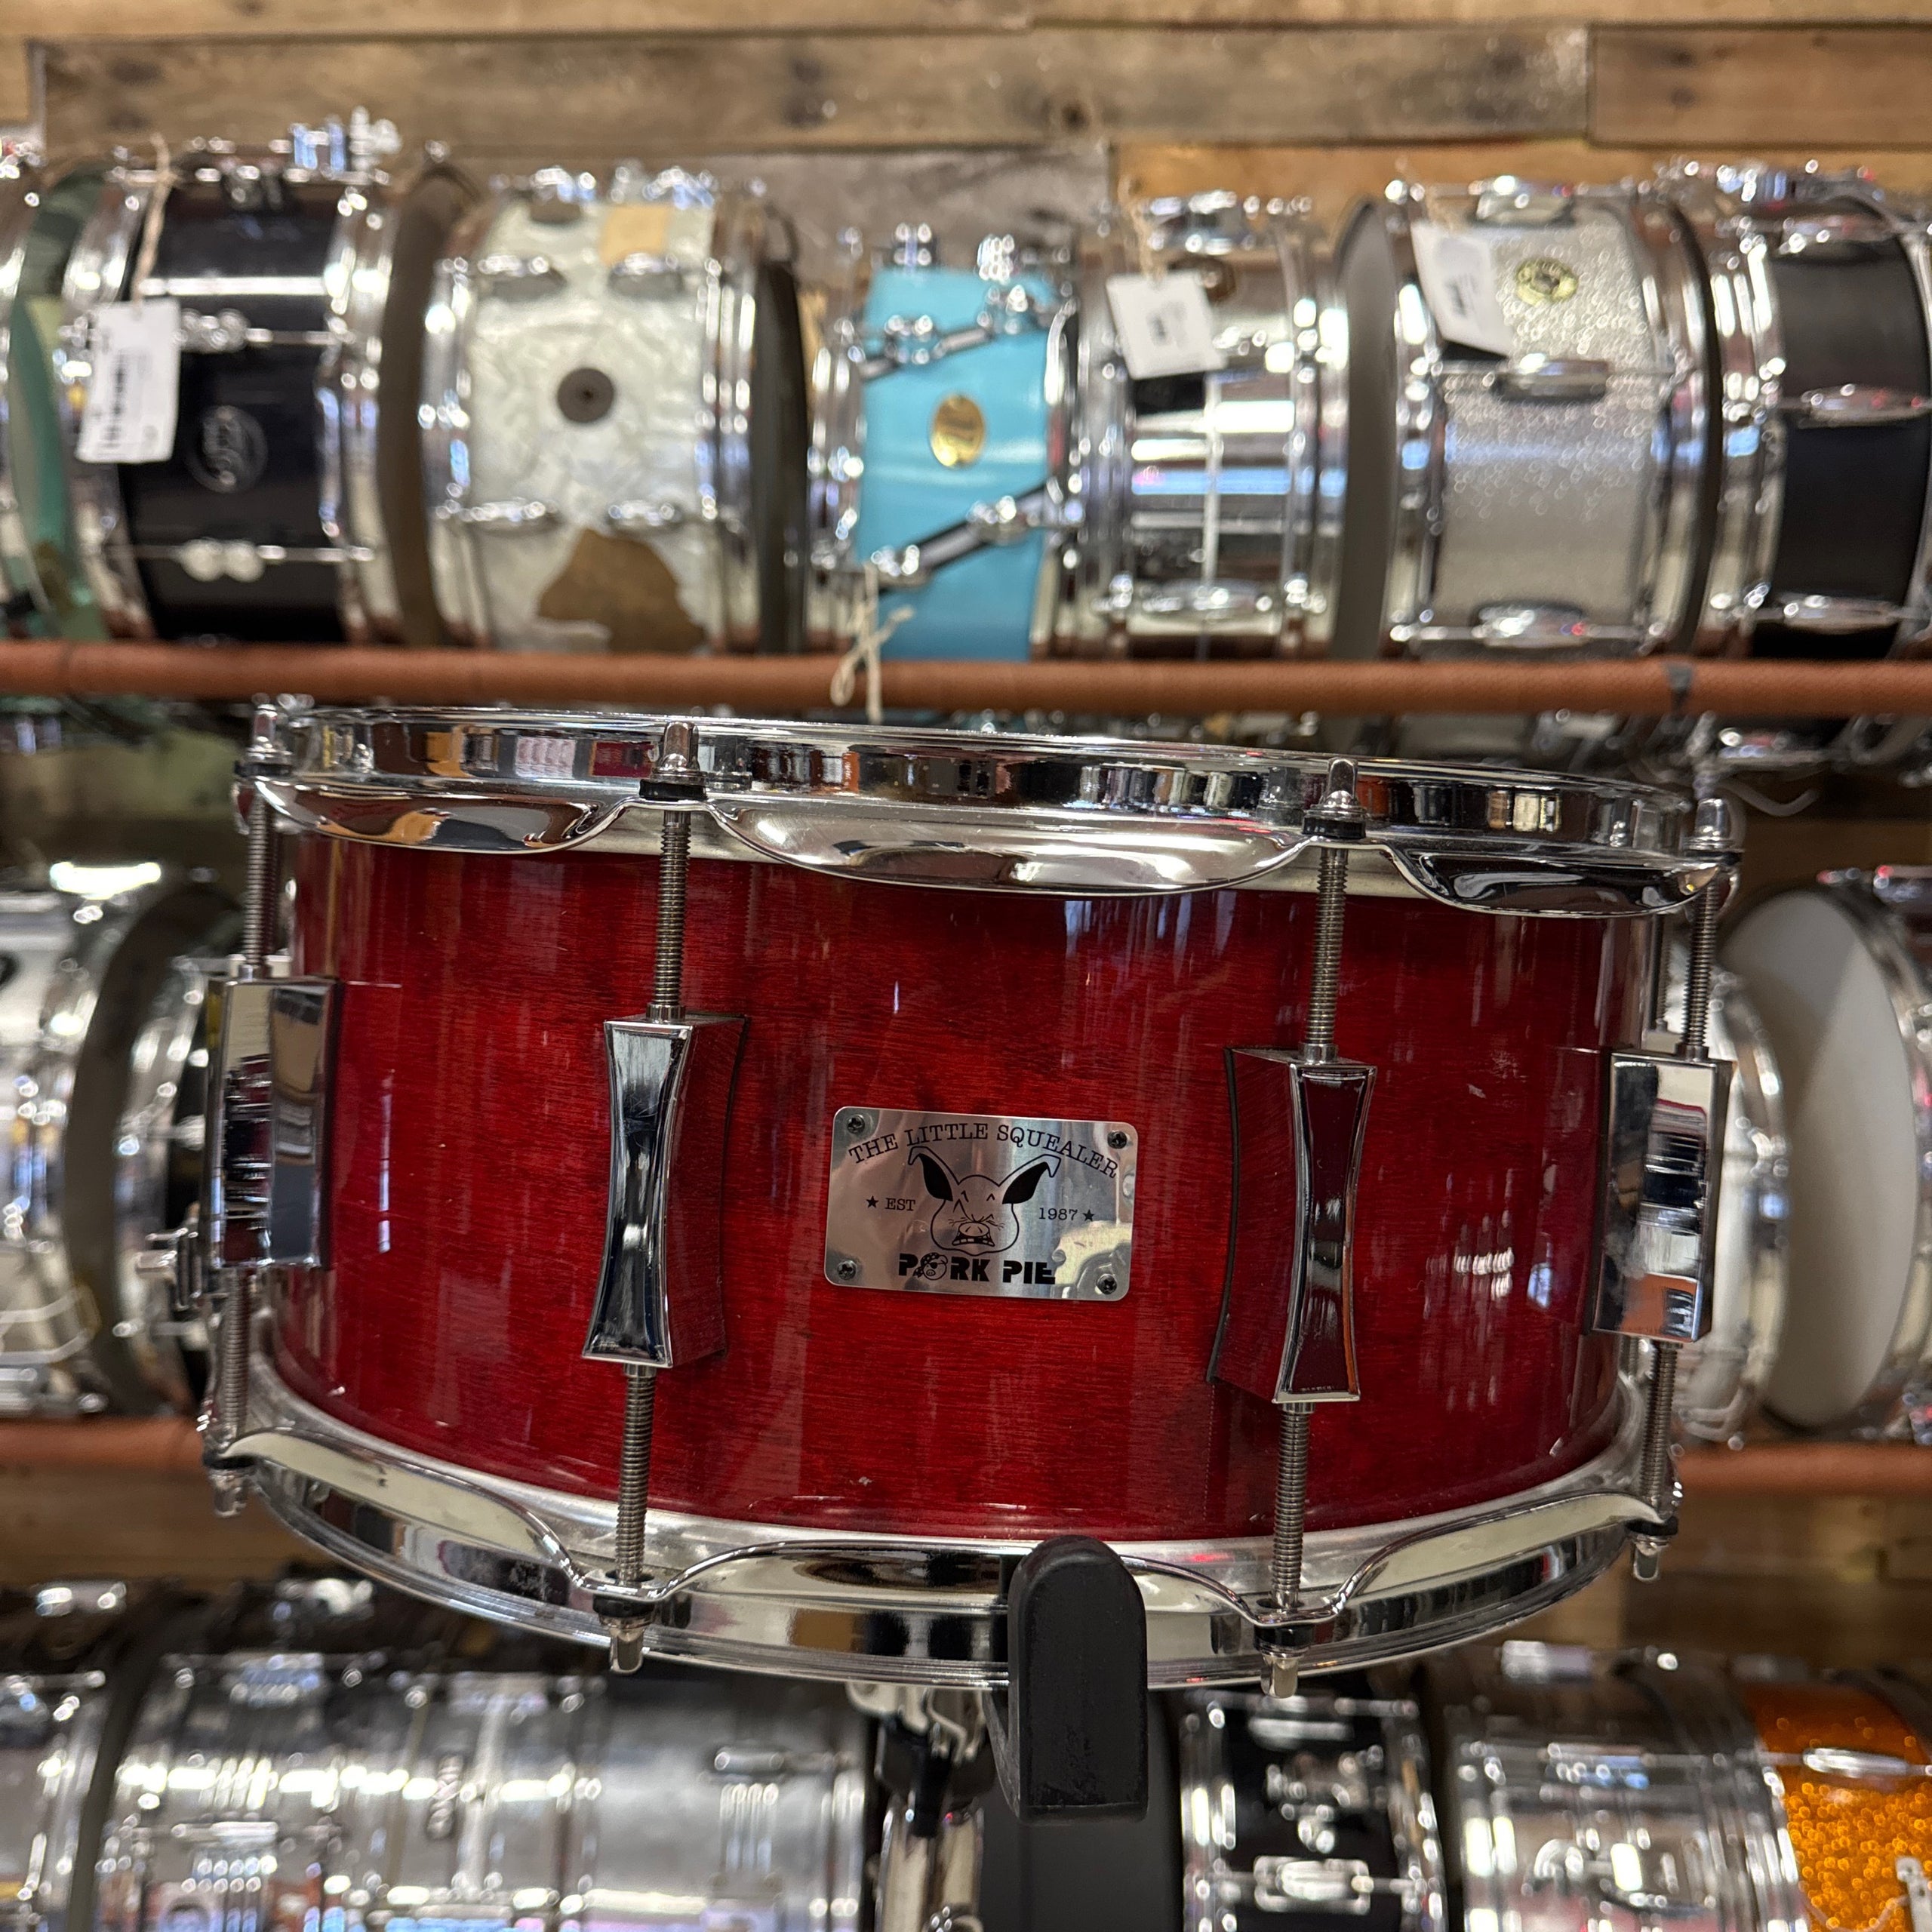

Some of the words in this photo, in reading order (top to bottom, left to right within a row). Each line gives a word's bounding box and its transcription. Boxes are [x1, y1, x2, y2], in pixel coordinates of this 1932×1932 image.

[848, 1134, 899, 1164] THE
[904, 1122, 988, 1146] LITTLE
[996, 1124, 1119, 1179] SQUEALER
[884, 1198, 915, 1211] EST
[1038, 1208, 1078, 1221] 1987
[898, 1252, 990, 1282] PORK
[1003, 1260, 1056, 1284] PIE
